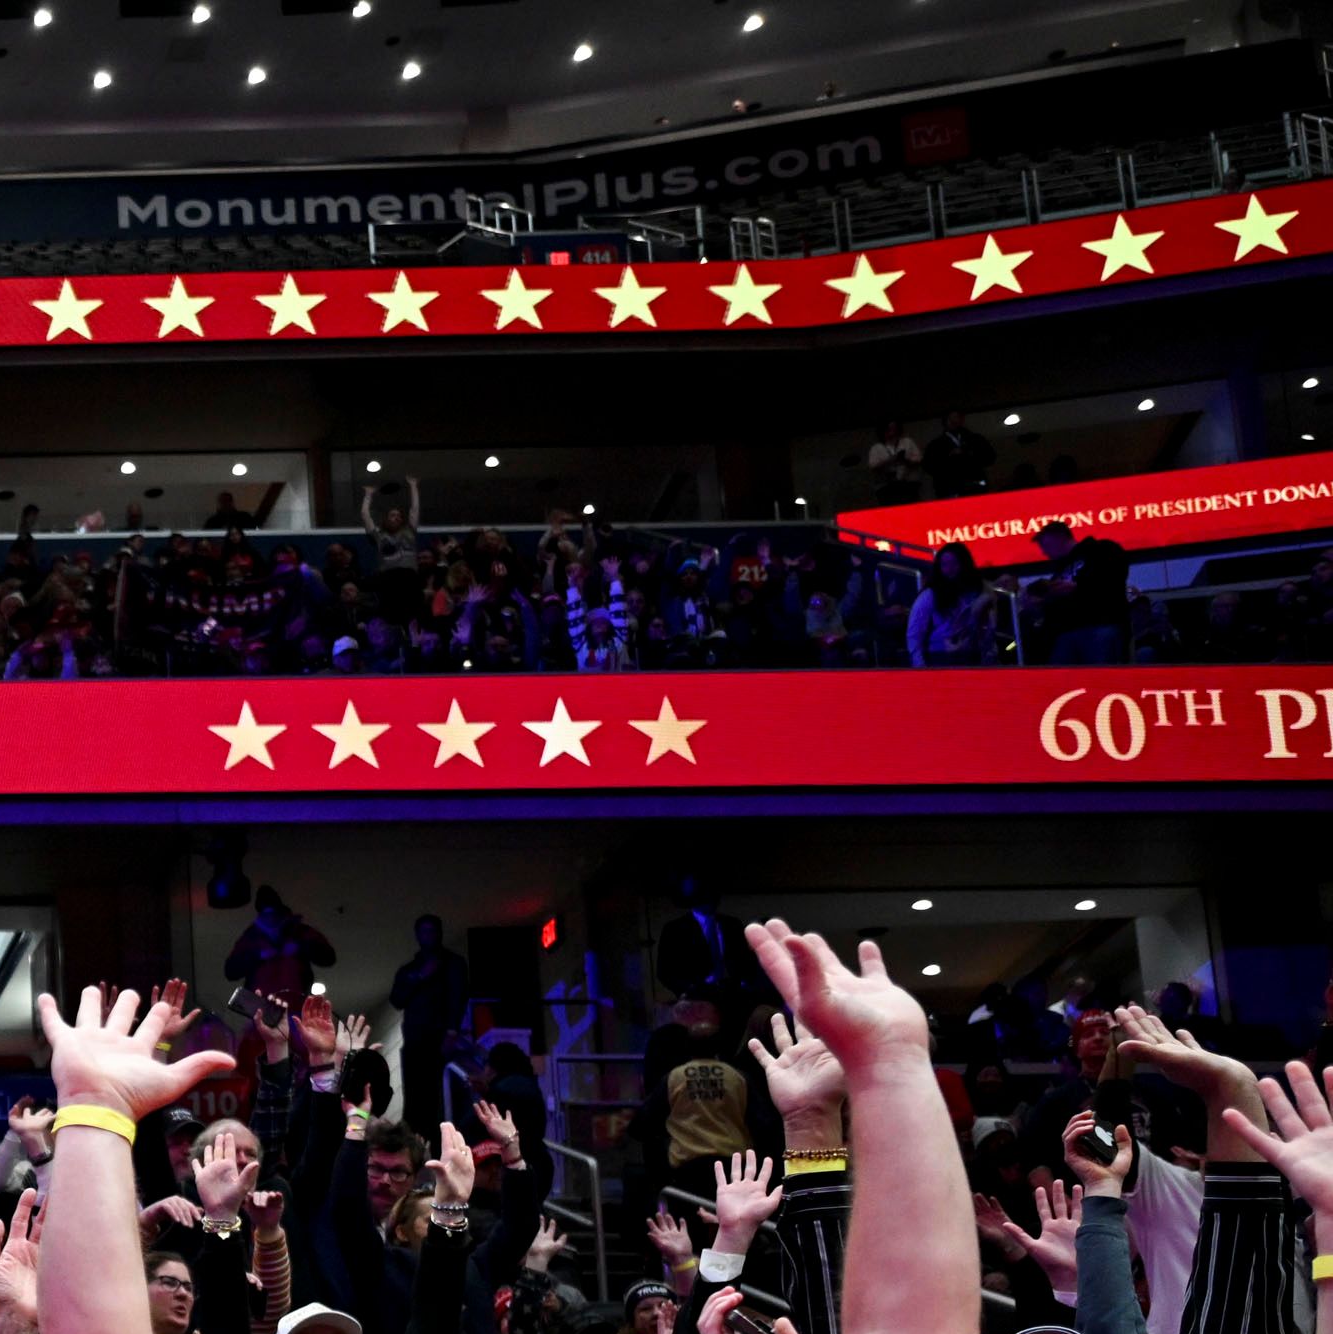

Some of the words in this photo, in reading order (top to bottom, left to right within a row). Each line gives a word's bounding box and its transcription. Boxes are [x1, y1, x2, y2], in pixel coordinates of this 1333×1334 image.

[1098, 505, 1129, 525] OF
[1134, 489, 1258, 520] PRESIDENT
[1039, 688, 1226, 761] 60TH
[684, 1065, 724, 1078] CSC
[686, 1079, 724, 1090] EVENT
[190, 1091, 239, 1117] 110
[688, 1090, 725, 1100] STAFF
